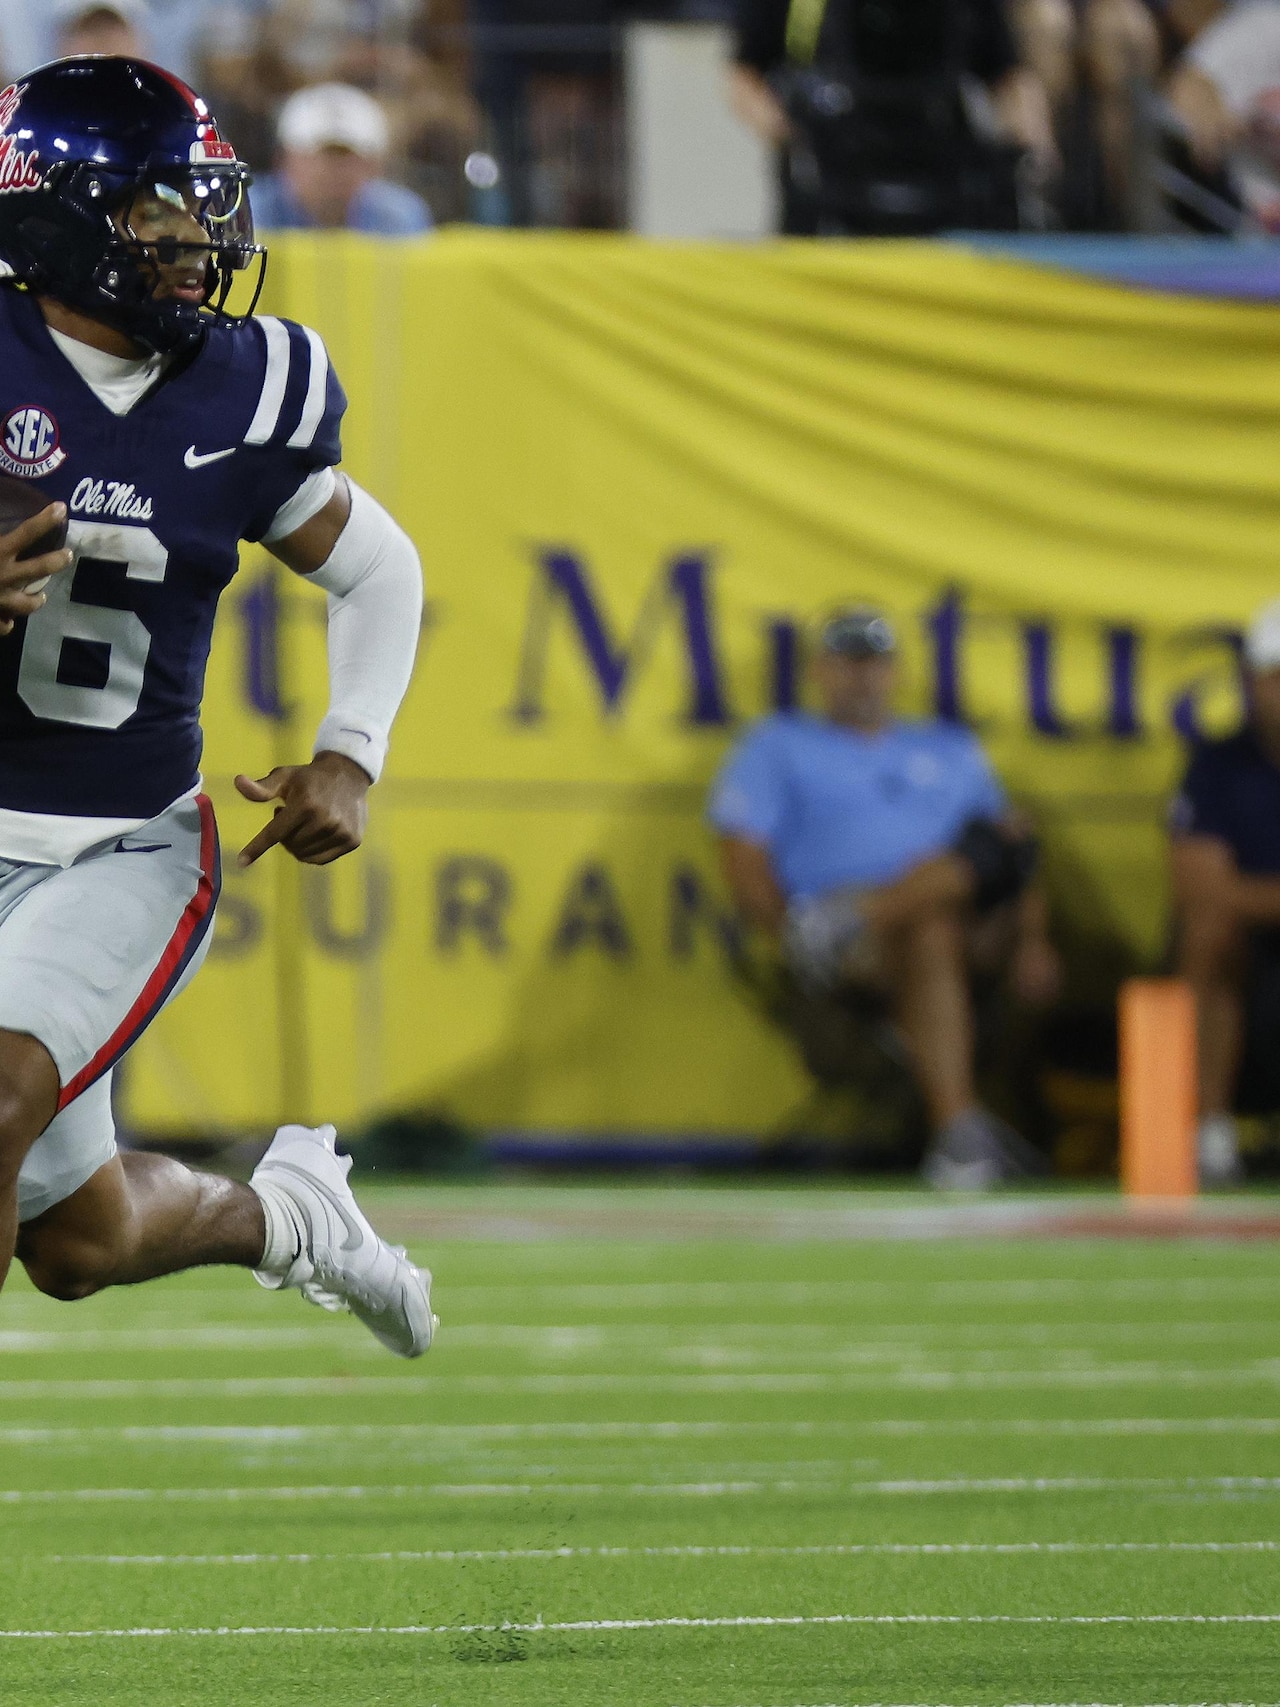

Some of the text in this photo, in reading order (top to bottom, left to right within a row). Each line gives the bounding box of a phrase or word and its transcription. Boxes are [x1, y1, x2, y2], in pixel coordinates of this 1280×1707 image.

[5, 408, 55, 459] SEC
[69, 477, 153, 520] Ole Miss
[17, 518, 169, 730] 6
[508, 543, 1256, 745] Mtua
